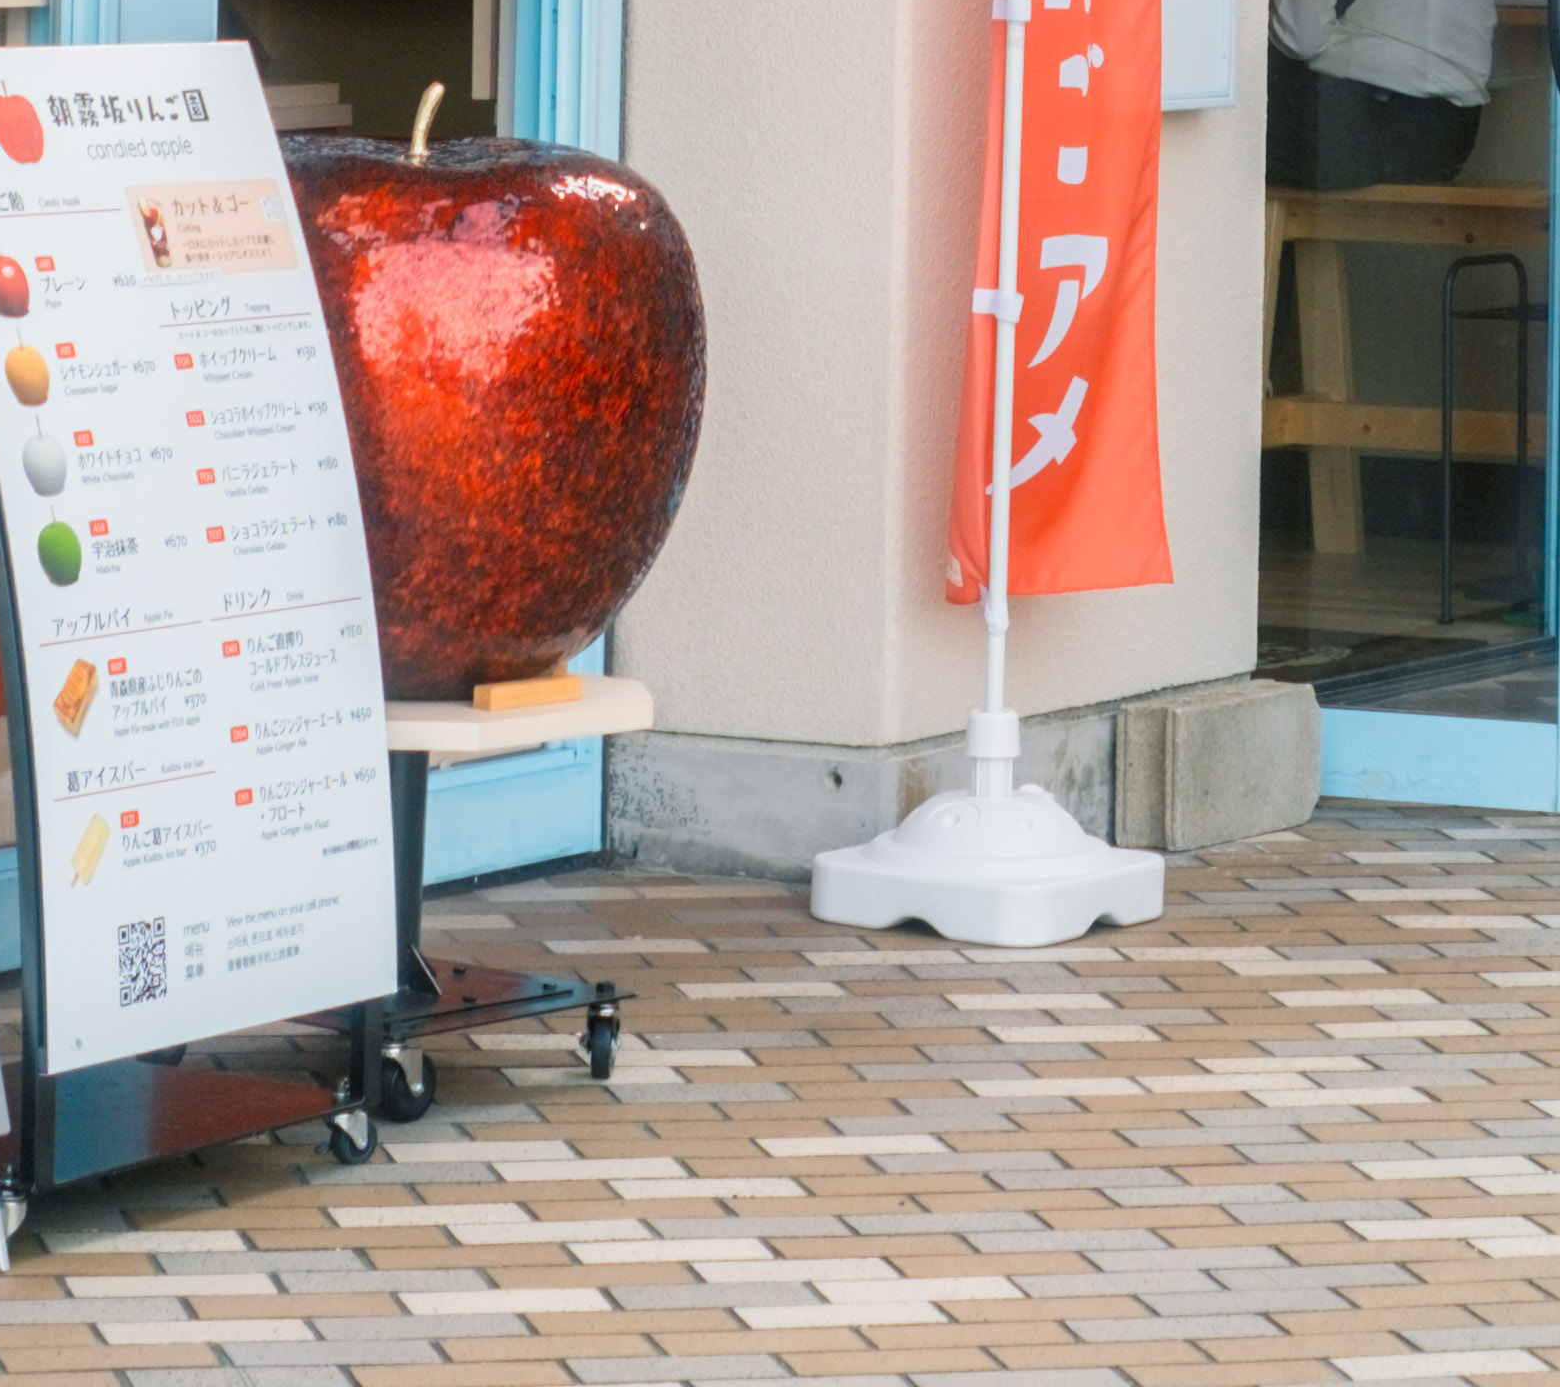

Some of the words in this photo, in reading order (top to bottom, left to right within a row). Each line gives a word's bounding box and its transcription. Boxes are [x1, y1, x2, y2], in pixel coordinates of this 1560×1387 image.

[46, 88, 210, 128] 朝霧坂りんご園
[86, 141, 148, 161] candied
[151, 135, 194, 161] apple
[39, 276, 87, 295] プレーン
[112, 274, 137, 288] ¥620
[170, 296, 231, 321] トッピング
[60, 359, 129, 381] シナモンシュガー
[199, 346, 278, 370] ホイップクリーム
[64, 385, 98, 397] Cinnamon
[210, 402, 302, 426] ショコラホイップクリーム
[77, 447, 142, 470] ホワイトチョコ
[221, 458, 299, 483] バニラジェラート
[230, 515, 317, 542] ショコラジェラート
[91, 536, 139, 561] 宇治抹茶
[223, 587, 272, 614] ドリンク
[51, 607, 132, 638] アップルパイ
[247, 630, 304, 654] りんご直搾り
[248, 647, 338, 677] コールドプレスジュース
[109, 668, 203, 700] 青森県産ふじりんごの
[112, 696, 167, 722] アップルパイ
[255, 709, 343, 740] りんごジンジャーエール
[259, 771, 349, 803] りんごジンジャーエール
[183, 921, 211, 936] menu
[226, 916, 244, 928] View
[244, 912, 256, 924] the
